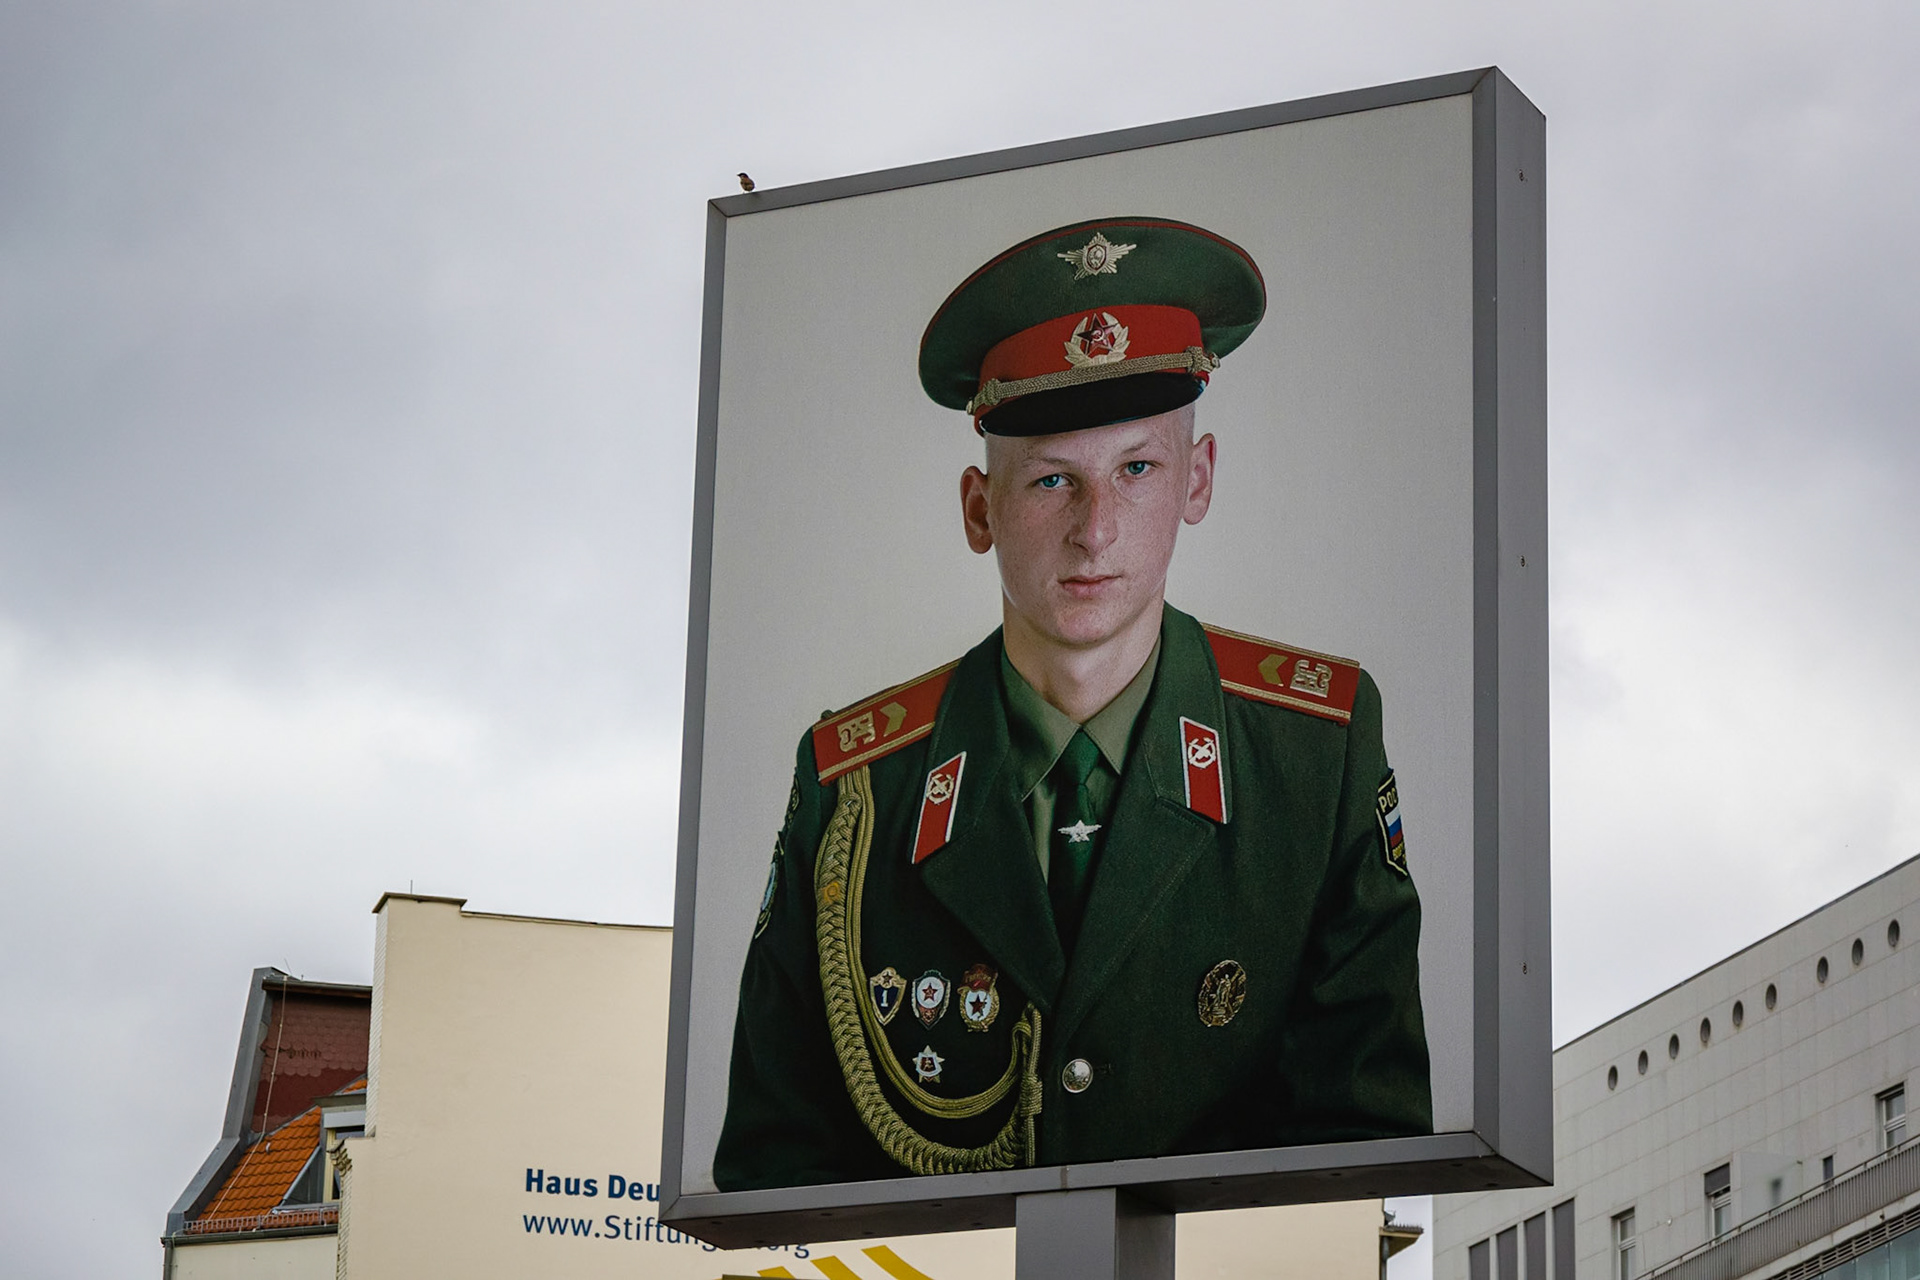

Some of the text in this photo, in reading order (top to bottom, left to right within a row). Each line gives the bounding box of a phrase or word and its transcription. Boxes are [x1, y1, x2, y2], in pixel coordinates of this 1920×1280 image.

[881, 990, 889, 1007] 1
[525, 1168, 660, 1202] Haus Deu
